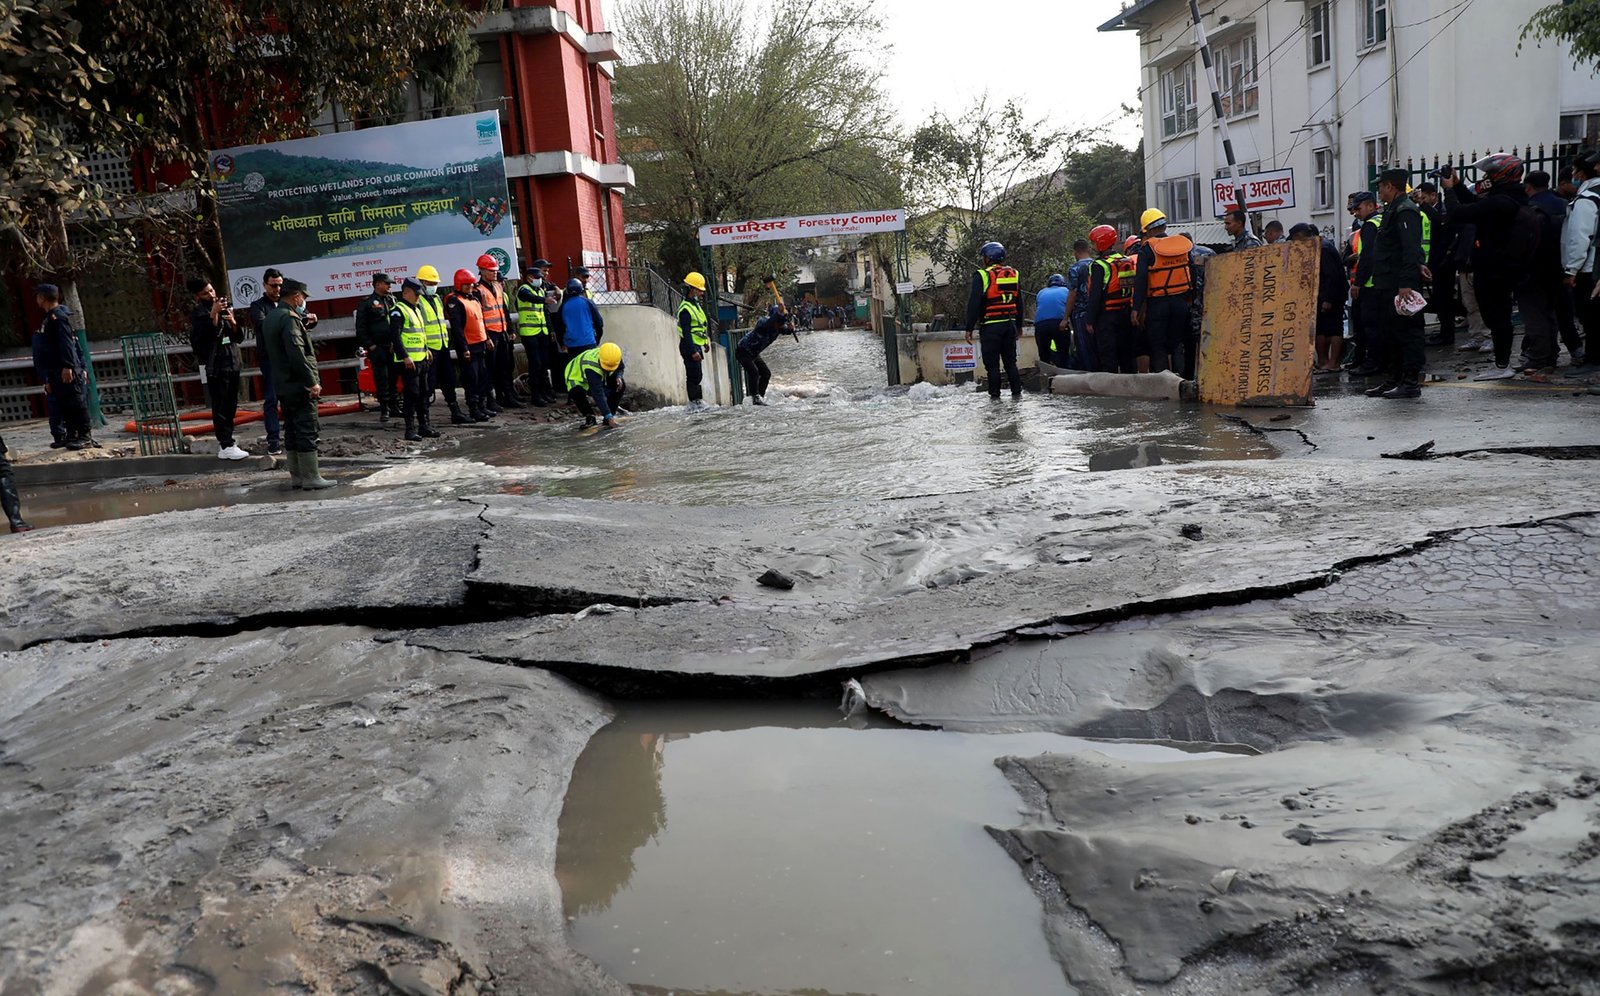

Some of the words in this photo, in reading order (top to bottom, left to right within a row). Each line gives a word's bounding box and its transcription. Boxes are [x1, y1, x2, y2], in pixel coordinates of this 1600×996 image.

[268, 185, 317, 199] PROTECTING
[319, 179, 364, 192] WETLANDS
[366, 176, 382, 186] FOR
[384, 174, 402, 183] OUR
[403, 168, 444, 180] COMMON
[446, 163, 479, 175] FUTURE
[1250, 177, 1291, 198] अदालत
[332, 193, 354, 202] Value.
[355, 189, 381, 199] Protect.
[383, 186, 409, 196] Inspire.
[327, 207, 356, 226] लागि
[360, 204, 406, 221] सिमसार
[798, 217, 849, 227] Forestry
[851, 213, 897, 225] Complex
[317, 230, 340, 243] विश्व
[343, 226, 380, 240] सिमसार
[710, 225, 733, 235] वन
[736, 220, 787, 233] परिसर
[1244, 255, 1255, 286] NEPAL
[1262, 265, 1277, 306] WORK
[1240, 292, 1254, 346] ELECTRICITY
[1260, 311, 1275, 327] IN
[1280, 326, 1296, 362] SLOW
[1256, 333, 1274, 393] PROGRESS
